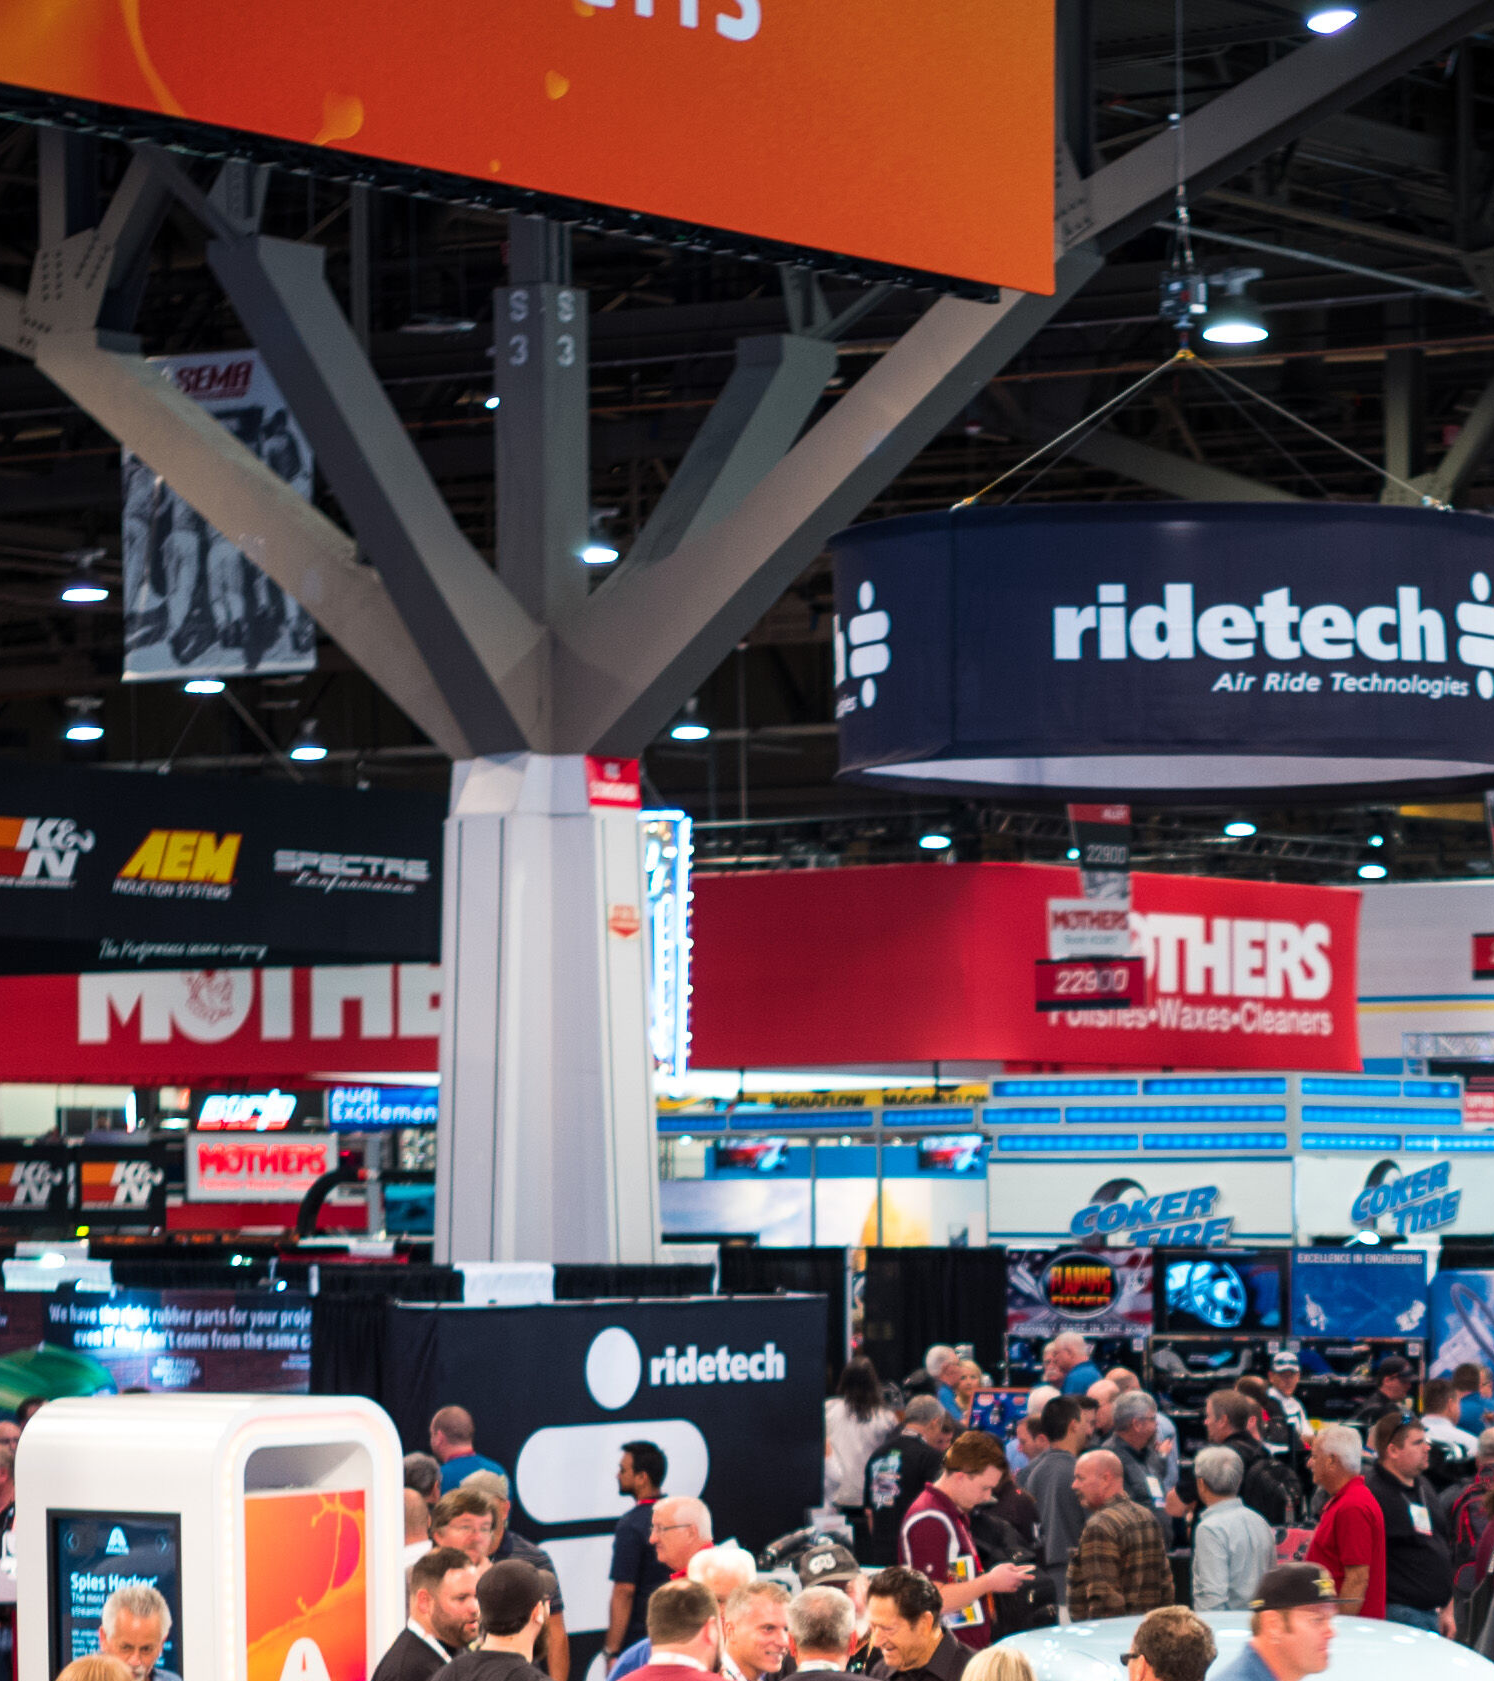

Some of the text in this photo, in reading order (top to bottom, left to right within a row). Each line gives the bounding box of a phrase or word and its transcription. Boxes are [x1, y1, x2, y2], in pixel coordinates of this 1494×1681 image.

[1053, 583, 1447, 663] ridetech
[1212, 672, 1470, 698] Air Ride Technologies
[116, 828, 243, 884] AEM
[273, 849, 431, 881] SPECTRE
[1055, 966, 1130, 995] 22900
[197, 1143, 329, 1175] MOTHERS
[1351, 1159, 1452, 1227] COKER
[1070, 1185, 1218, 1238] COKER
[1395, 1189, 1462, 1235] TIRE
[1297, 1252, 1423, 1266] EXCELLENCE IN ENGINEERING
[1049, 1266, 1113, 1293] FLAMING
[49, 1304, 68, 1325] We
[69, 1304, 98, 1325] have
[152, 1306, 191, 1327] rubber
[194, 1307, 226, 1330] parts
[227, 1307, 247, 1328] for
[249, 1309, 278, 1331] your
[74, 1331, 104, 1349] even
[175, 1332, 208, 1350] come
[210, 1329, 240, 1350] from
[242, 1330, 262, 1350] the
[264, 1333, 298, 1351] same
[649, 1342, 786, 1387] ridetech
